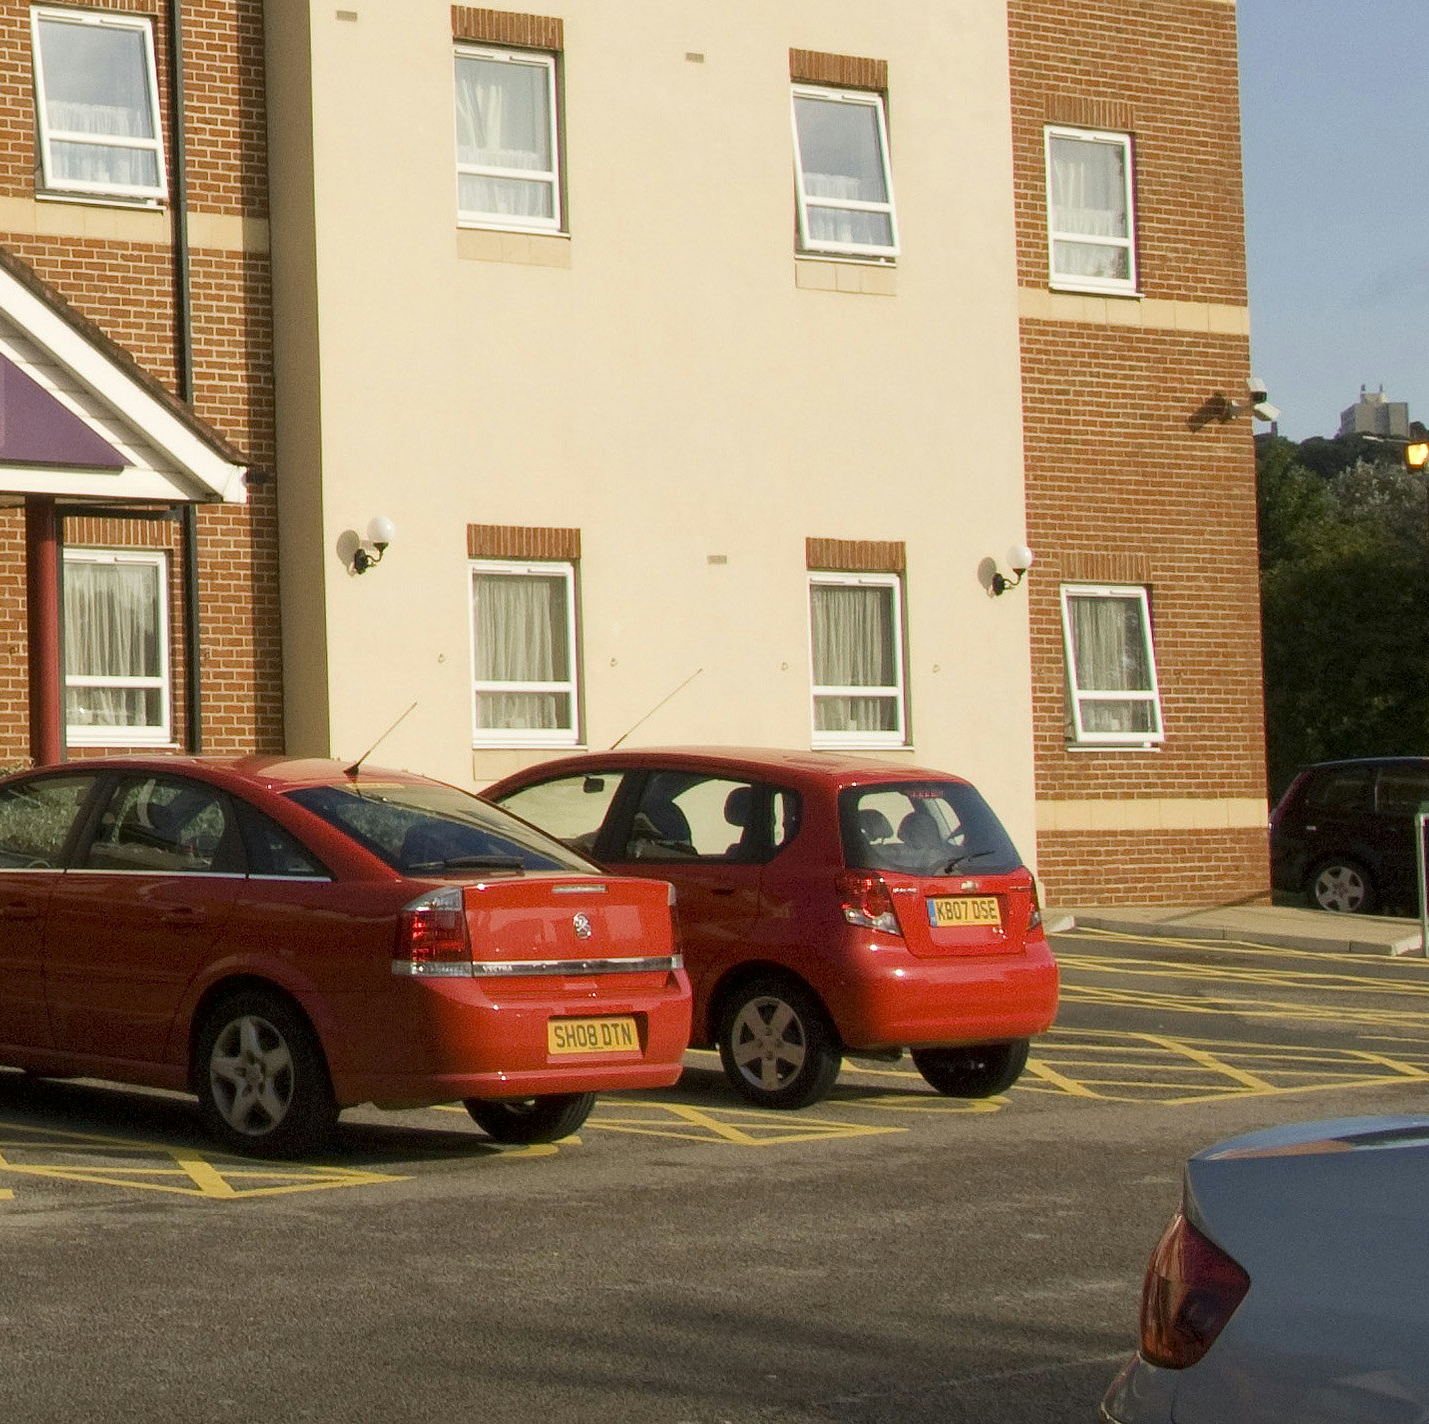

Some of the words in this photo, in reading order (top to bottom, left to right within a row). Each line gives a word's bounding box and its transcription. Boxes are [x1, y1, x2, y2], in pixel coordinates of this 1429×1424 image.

[936, 901, 968, 921] KB07
[972, 899, 998, 920] DSE
[554, 1024, 599, 1049] SH08
[602, 1022, 633, 1047] DTN
